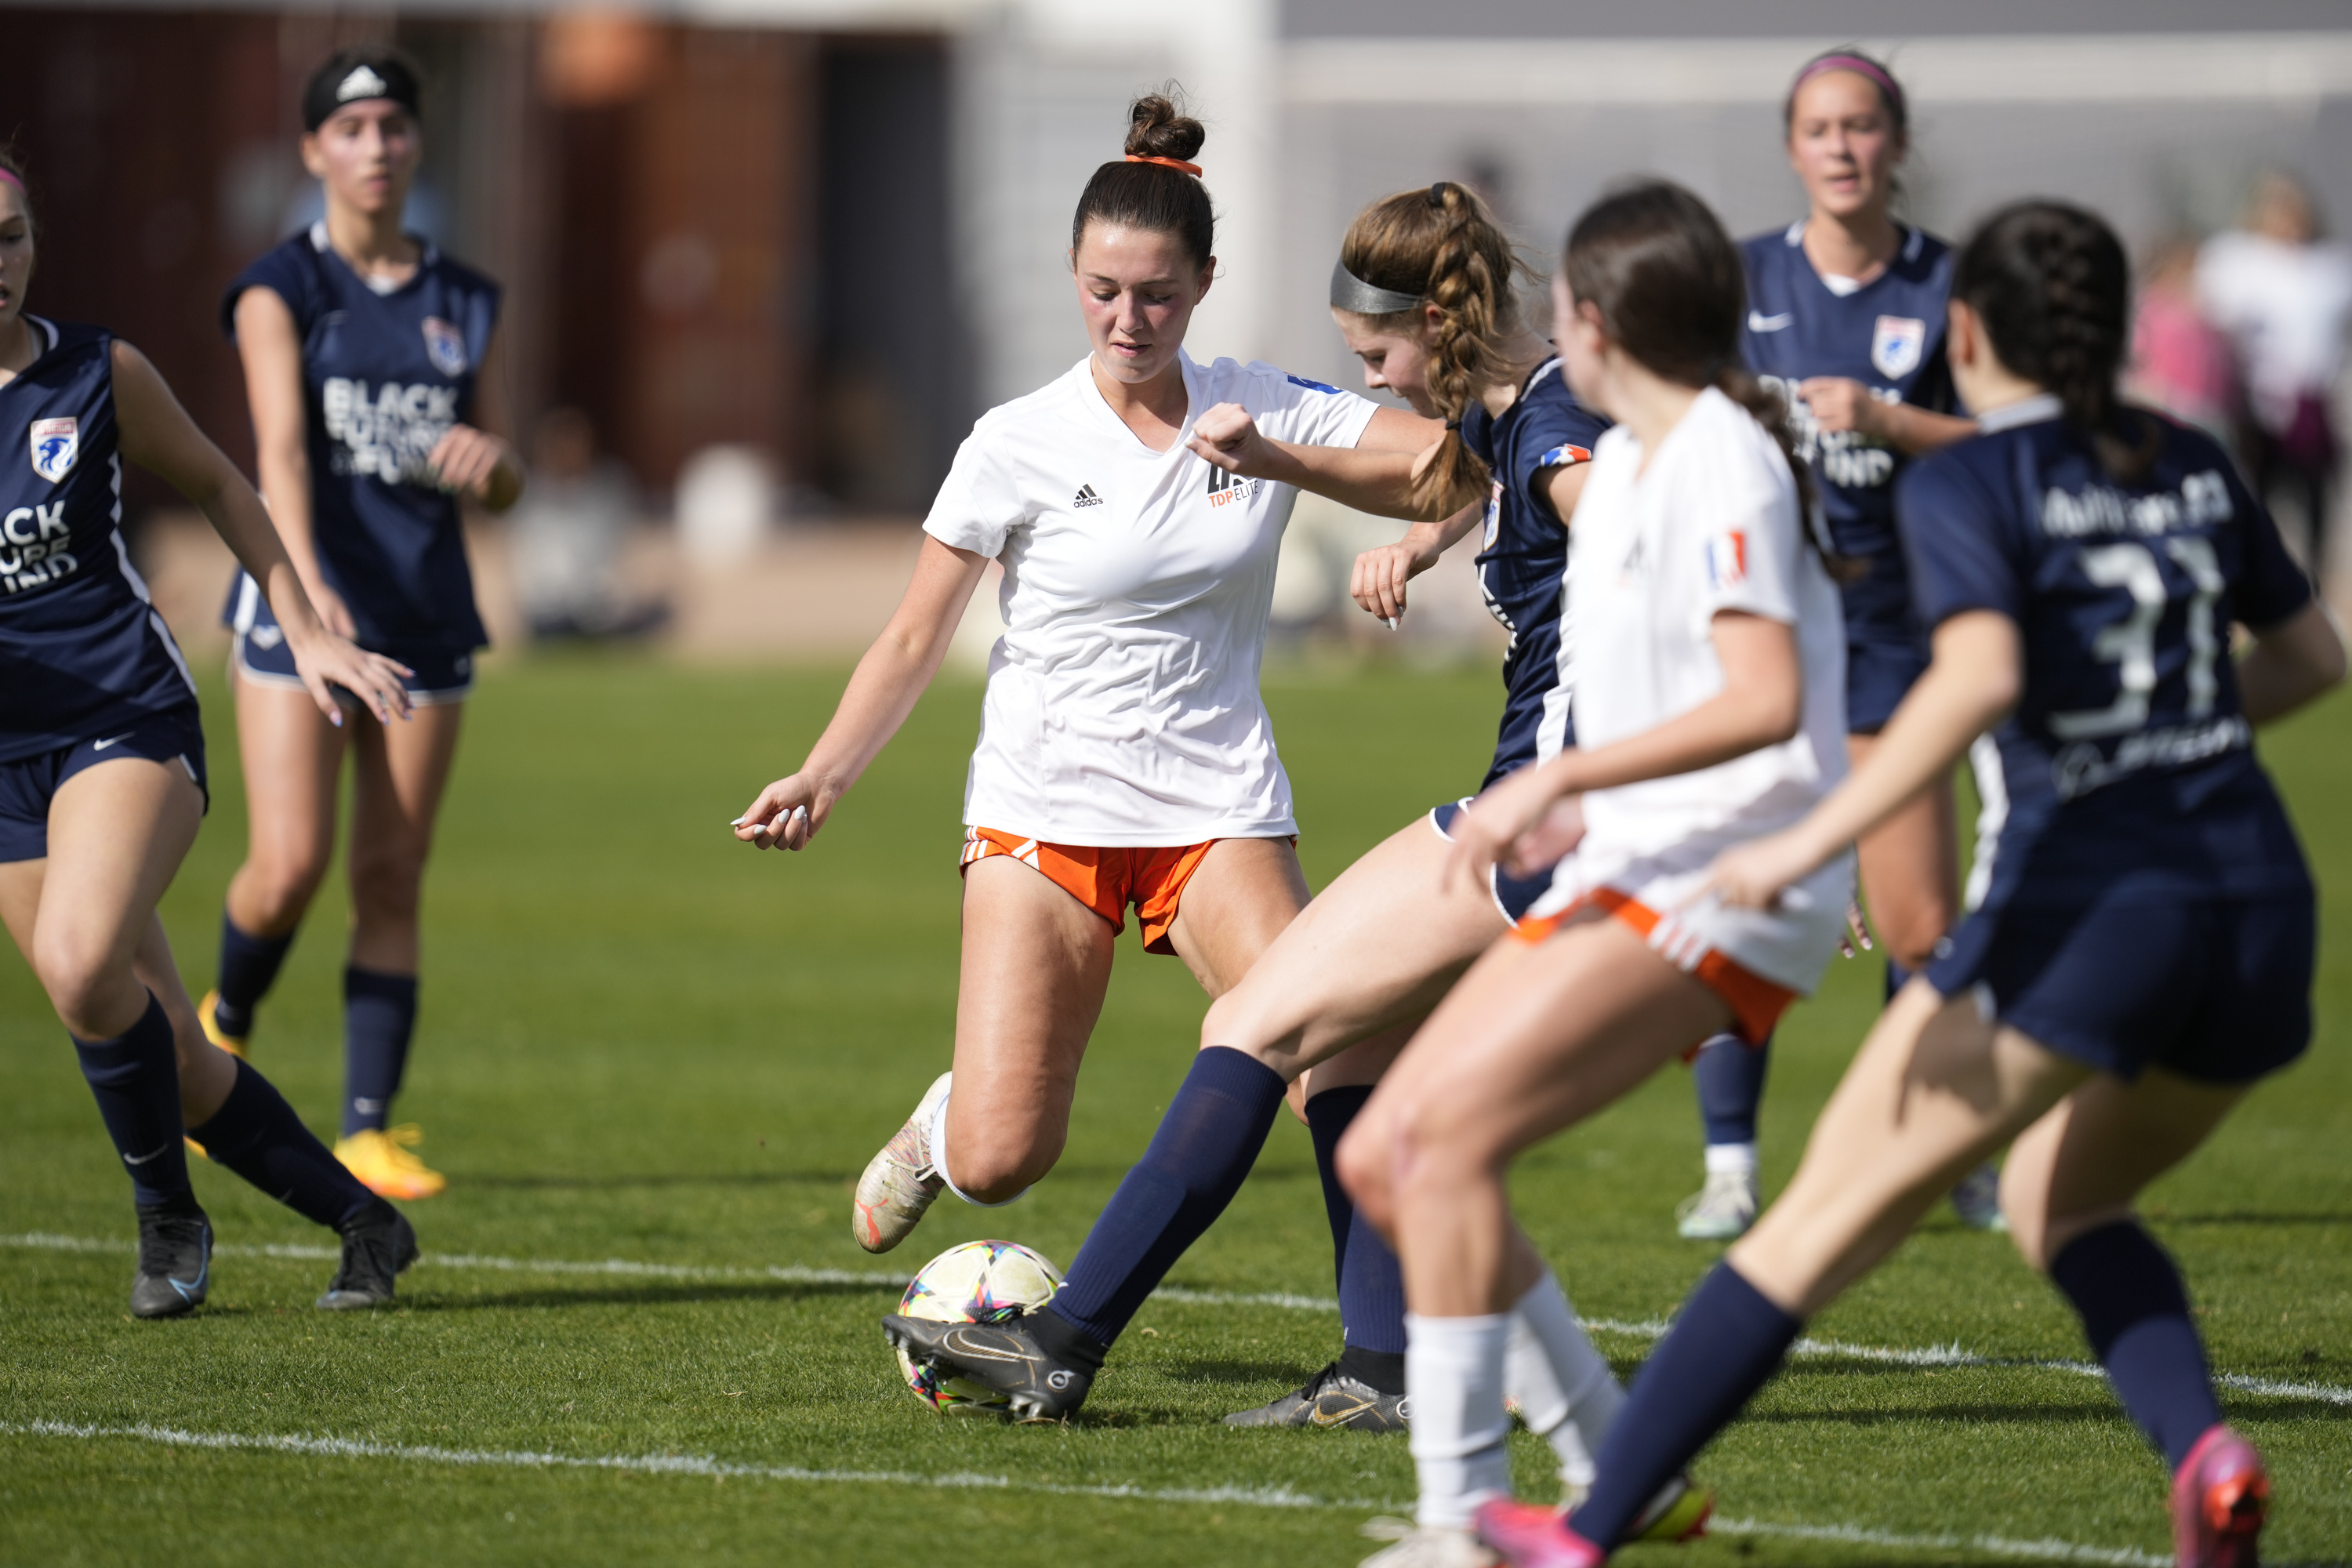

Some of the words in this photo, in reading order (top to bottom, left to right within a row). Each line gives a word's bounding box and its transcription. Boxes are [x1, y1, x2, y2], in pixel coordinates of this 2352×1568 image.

[323, 376, 459, 422] BLACK
[1073, 497, 1104, 508] adidas
[1208, 491, 1233, 508] TDP
[1234, 480, 1258, 501] ELITE
[2048, 536, 2225, 741] 31
